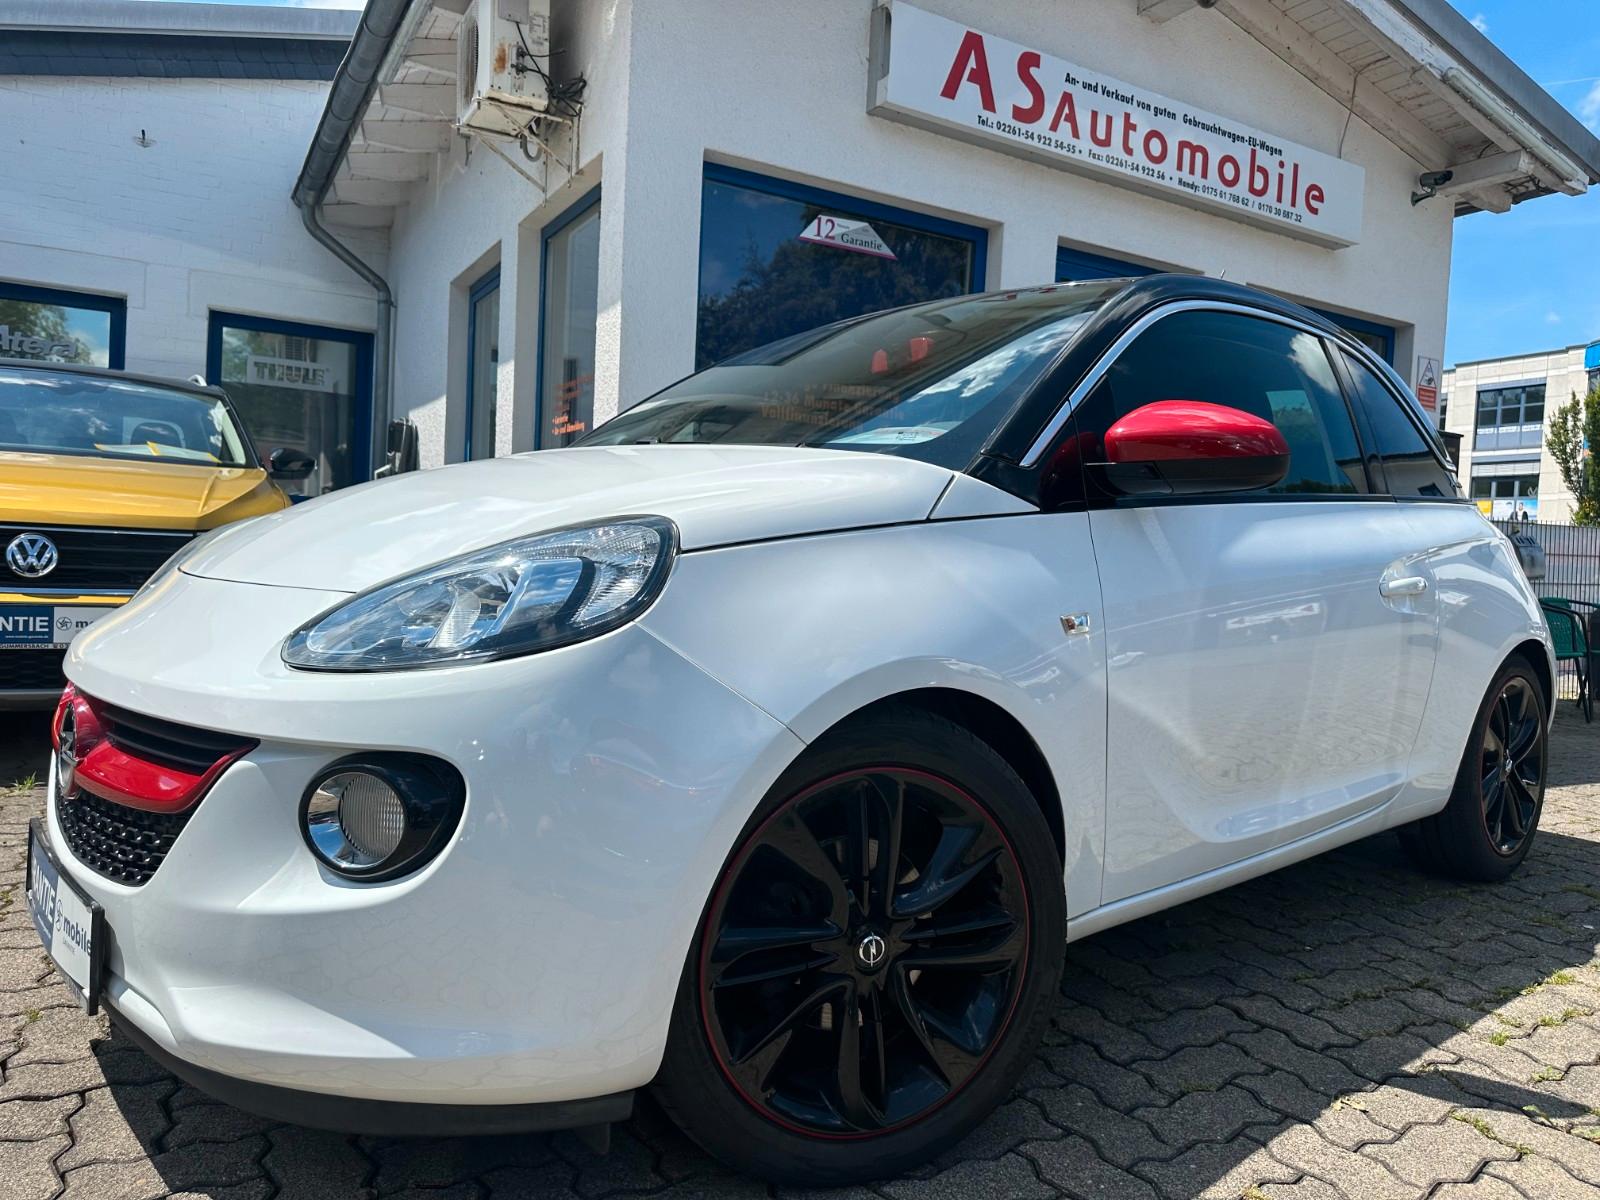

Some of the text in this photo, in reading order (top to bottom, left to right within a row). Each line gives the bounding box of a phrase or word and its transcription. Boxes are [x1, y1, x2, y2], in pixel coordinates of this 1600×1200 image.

[1064, 72, 1080, 86] An-
[1082, 80, 1099, 94] und
[1101, 85, 1134, 106] Verkauf
[1136, 99, 1151, 111] von
[1153, 105, 1177, 120] guten
[977, 115, 994, 129] Tel.:
[996, 121, 1035, 141] 02261-54
[1037, 134, 1052, 147] 922
[1088, 149, 1103, 161] Fax:
[1105, 154, 1140, 172] 02261-54
[1141, 166, 1155, 178] 922
[1177, 177, 1200, 193] Handy:
[813, 216, 883, 251] 12 Garantie
